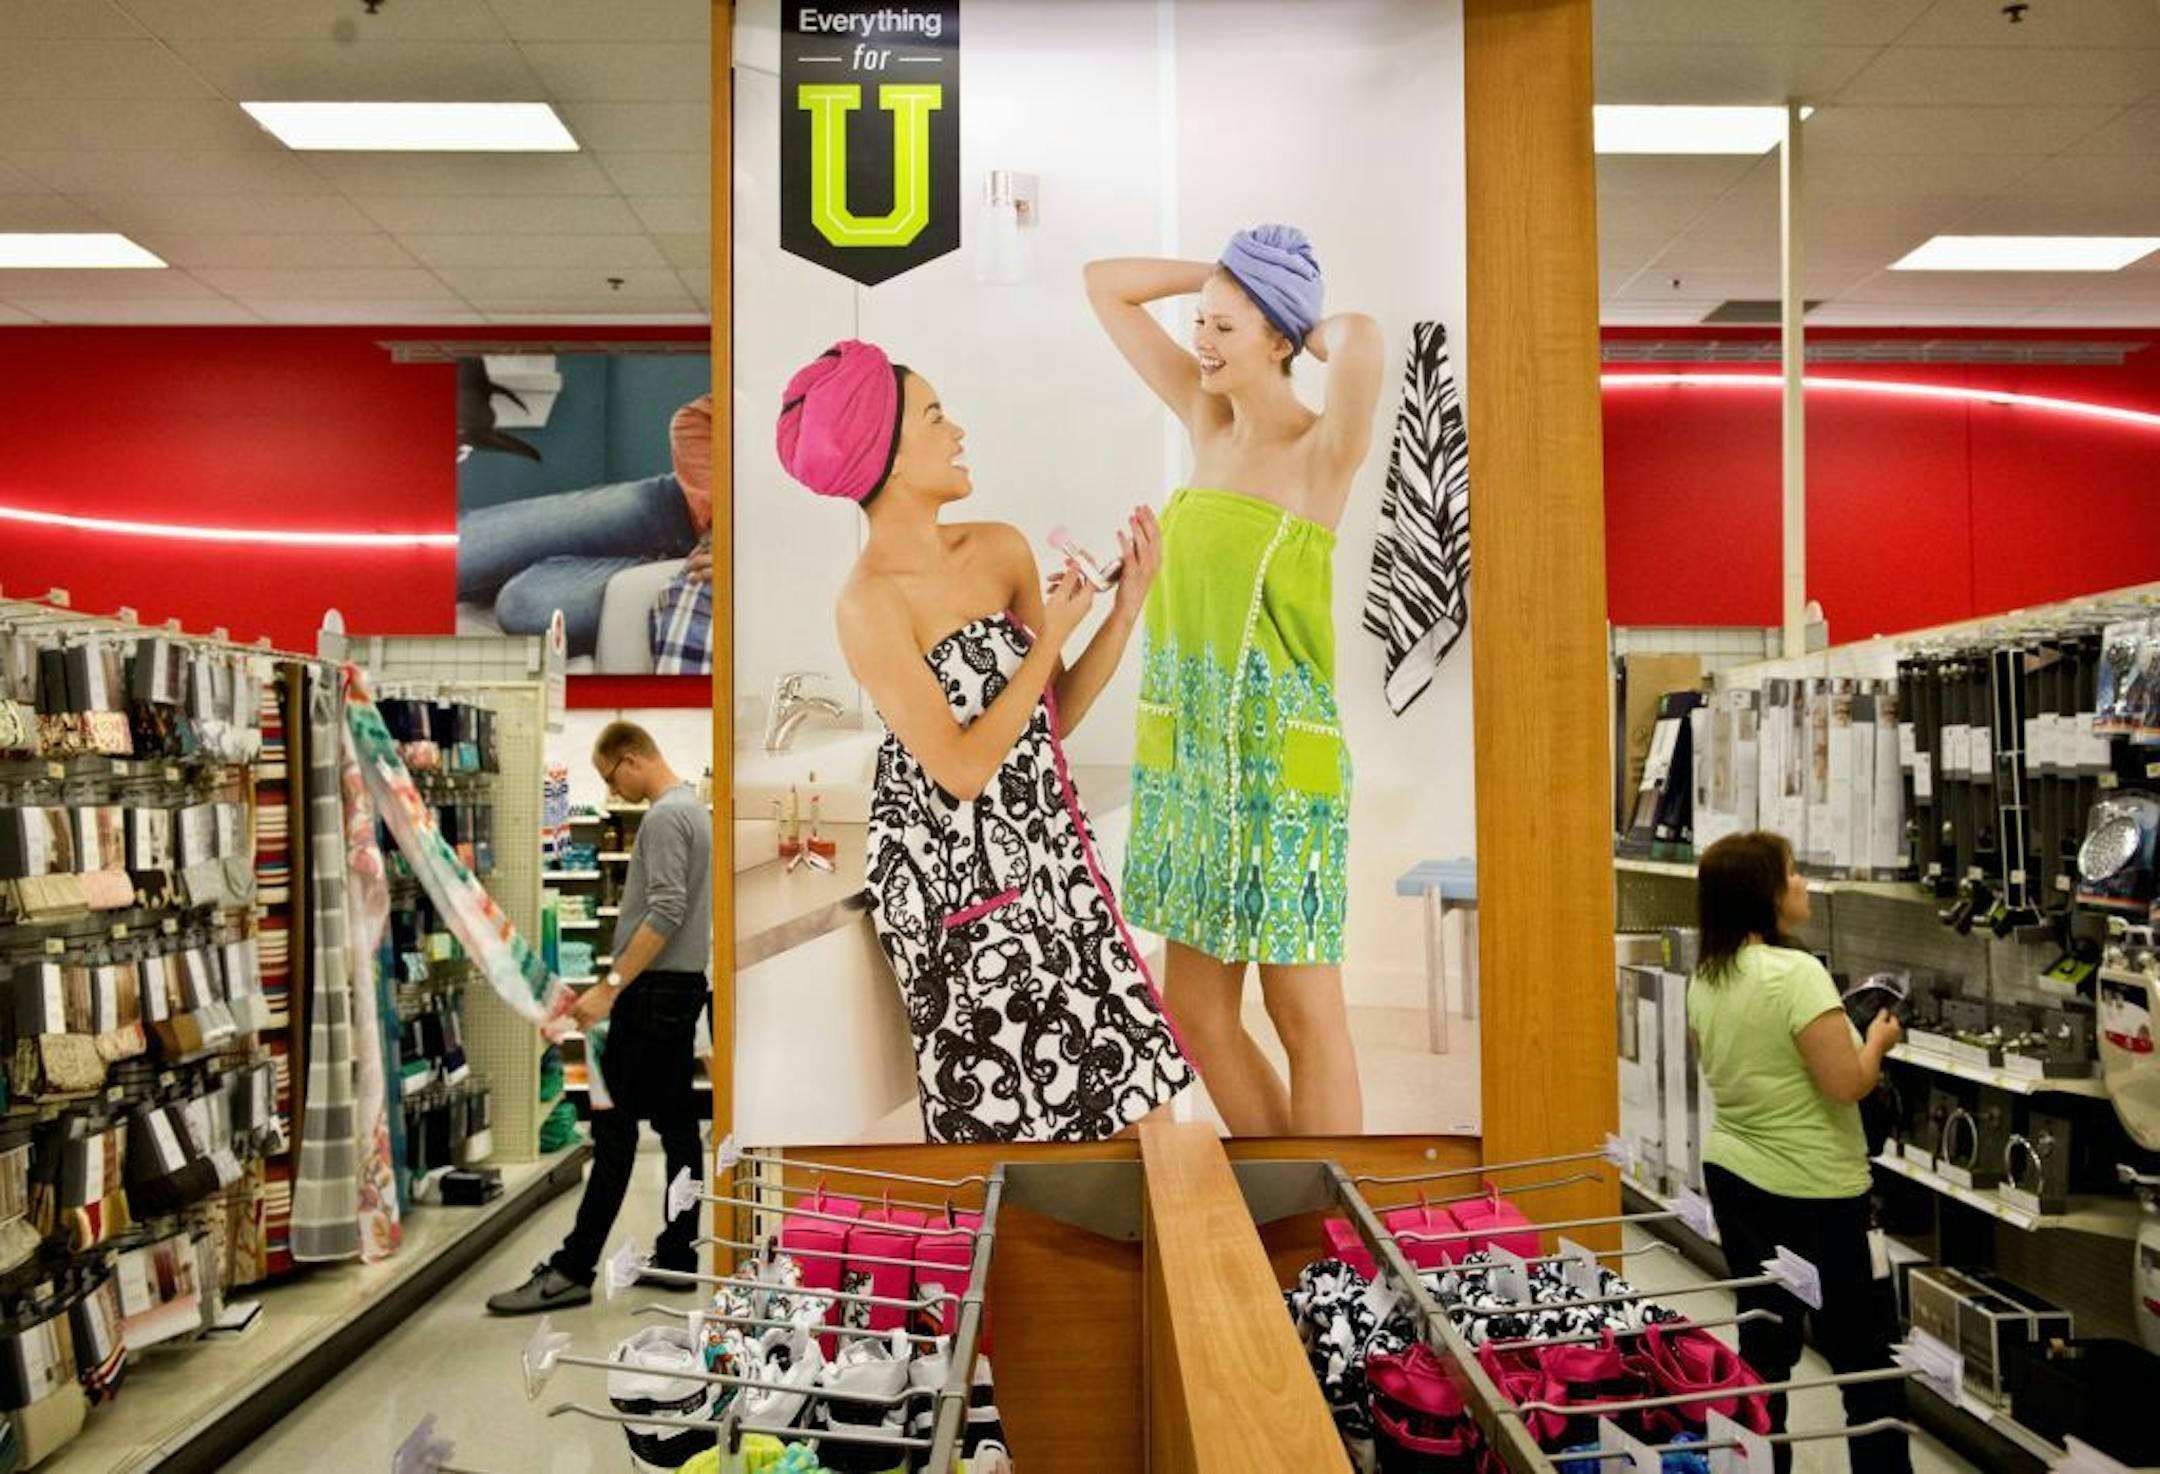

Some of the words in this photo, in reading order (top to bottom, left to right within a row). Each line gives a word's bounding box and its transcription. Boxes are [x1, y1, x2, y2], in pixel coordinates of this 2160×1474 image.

[799, 9, 942, 37] Everything
[852, 44, 891, 70] for
[798, 84, 942, 247] U
